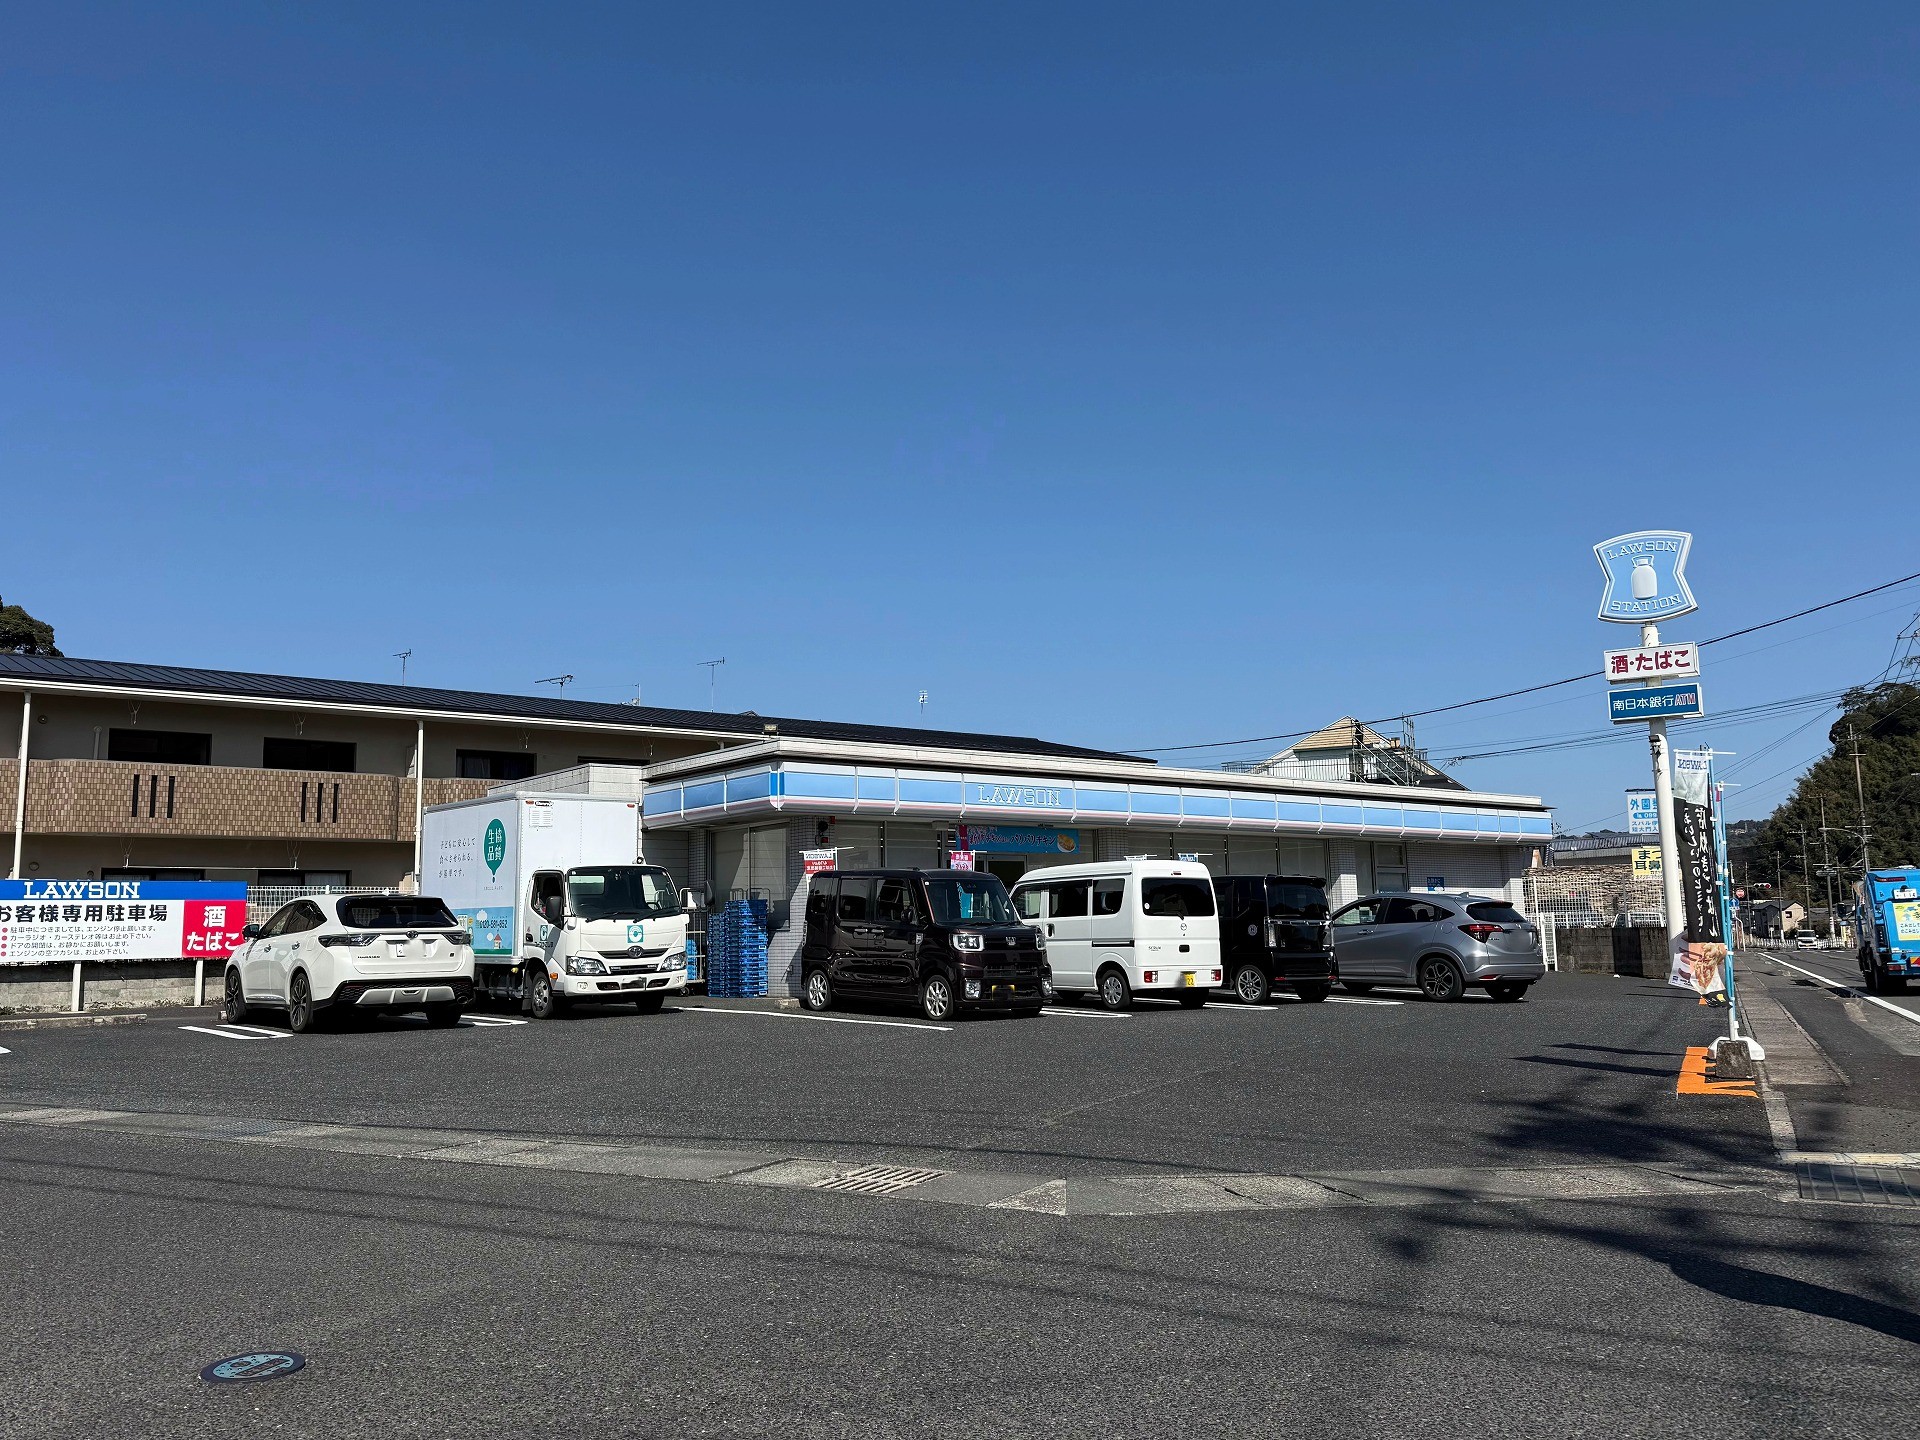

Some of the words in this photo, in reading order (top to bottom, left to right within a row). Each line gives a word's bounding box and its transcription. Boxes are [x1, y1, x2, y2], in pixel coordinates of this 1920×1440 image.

[1607, 541, 1677, 560] LAWSON
[1611, 594, 1682, 612] STATION
[1611, 650, 1690, 674] 酒・たばこ
[978, 785, 1061, 806] LAWSON
[23, 881, 141, 899] LAWSON
[0, 904, 168, 922] お客様専用駐車場
[203, 905, 227, 927] 酒
[186, 931, 240, 951] たばこ
